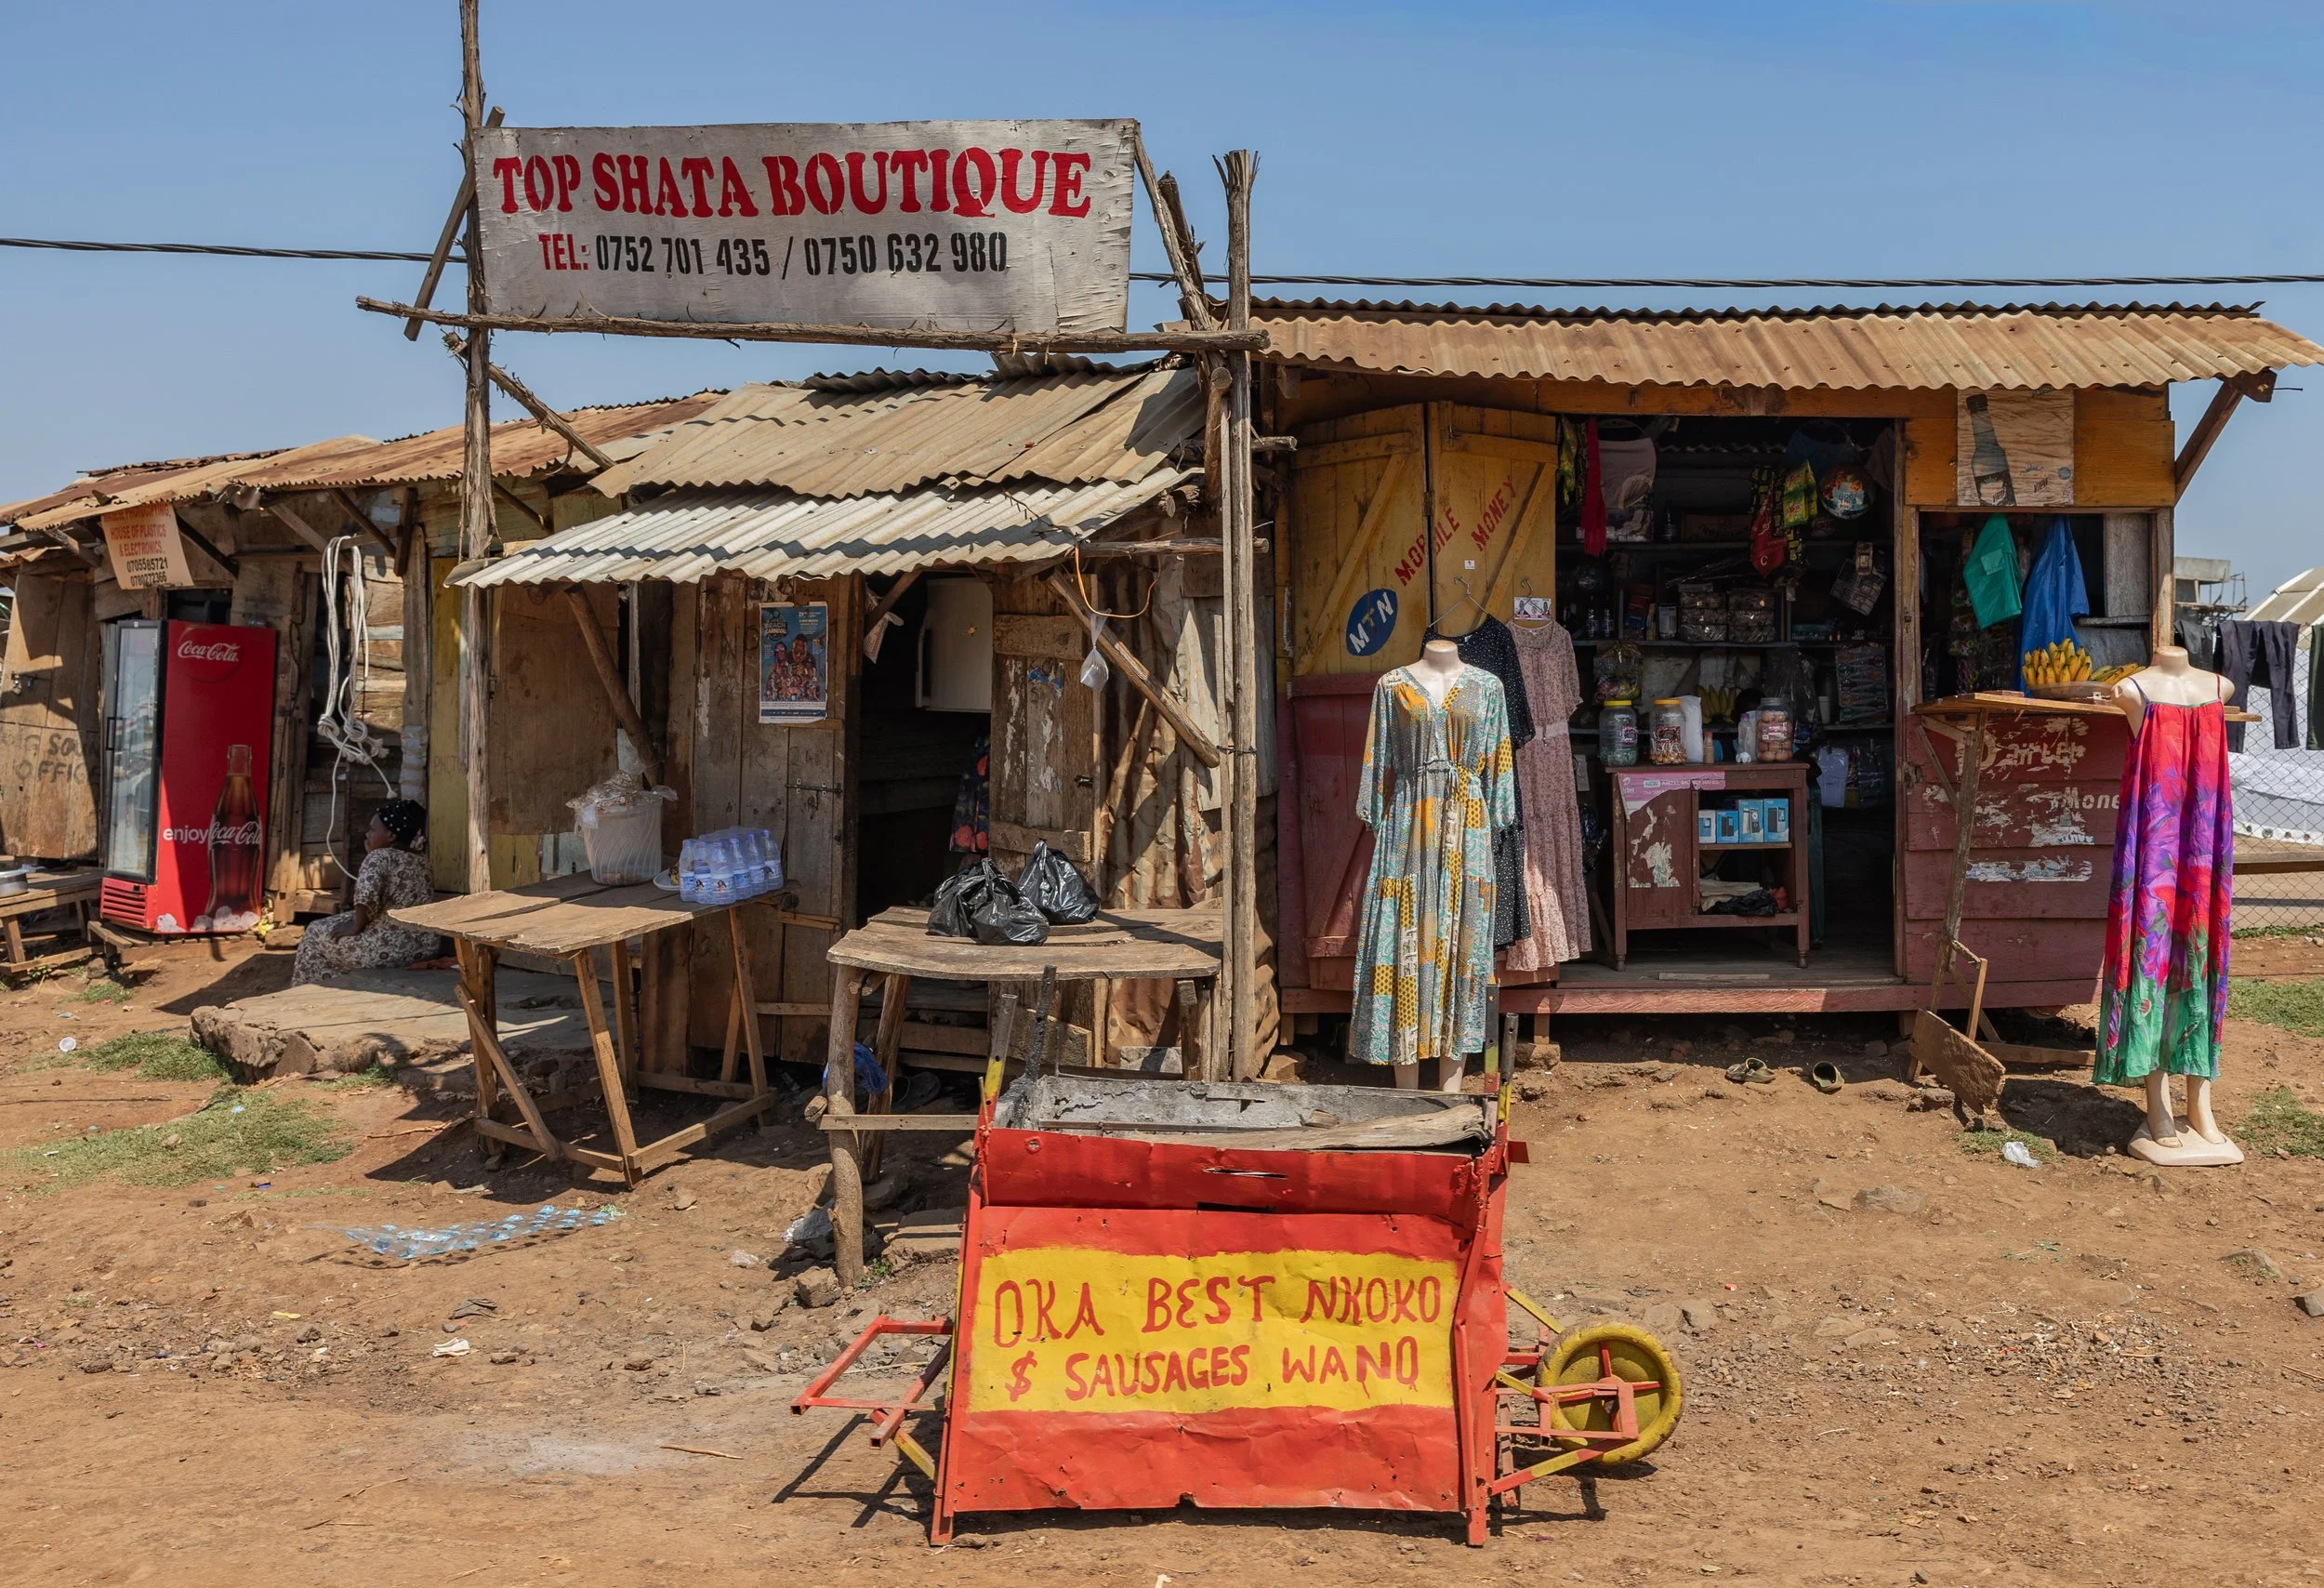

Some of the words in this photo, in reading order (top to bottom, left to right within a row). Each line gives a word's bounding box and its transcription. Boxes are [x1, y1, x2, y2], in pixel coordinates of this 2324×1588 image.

[494, 155, 581, 214] TOP
[593, 152, 759, 218] SHATA
[762, 147, 1090, 218] BOUTIQUE
[539, 233, 589, 271] TEL:
[596, 234, 654, 272] 0752
[661, 237, 703, 277] 701
[716, 238, 771, 276] 435
[781, 235, 794, 281] /
[804, 234, 876, 276] 0750
[888, 232, 942, 273] 632
[950, 232, 1007, 272] 980
[111, 525, 130, 540] HOUSE
[131, 524, 139, 538] OF
[140, 523, 167, 538] PLASTICS
[1471, 475, 1517, 551] MONEY
[1349, 591, 1394, 653] MTN
[178, 640, 241, 662] Coca-Cola
[2061, 787, 2119, 810] Mone
[163, 825, 208, 844] enjoy
[1141, 1275, 1276, 1333] BEST
[1300, 1275, 1442, 1326] NKOKO
[1065, 1344, 1250, 1401] SAUSAGES
